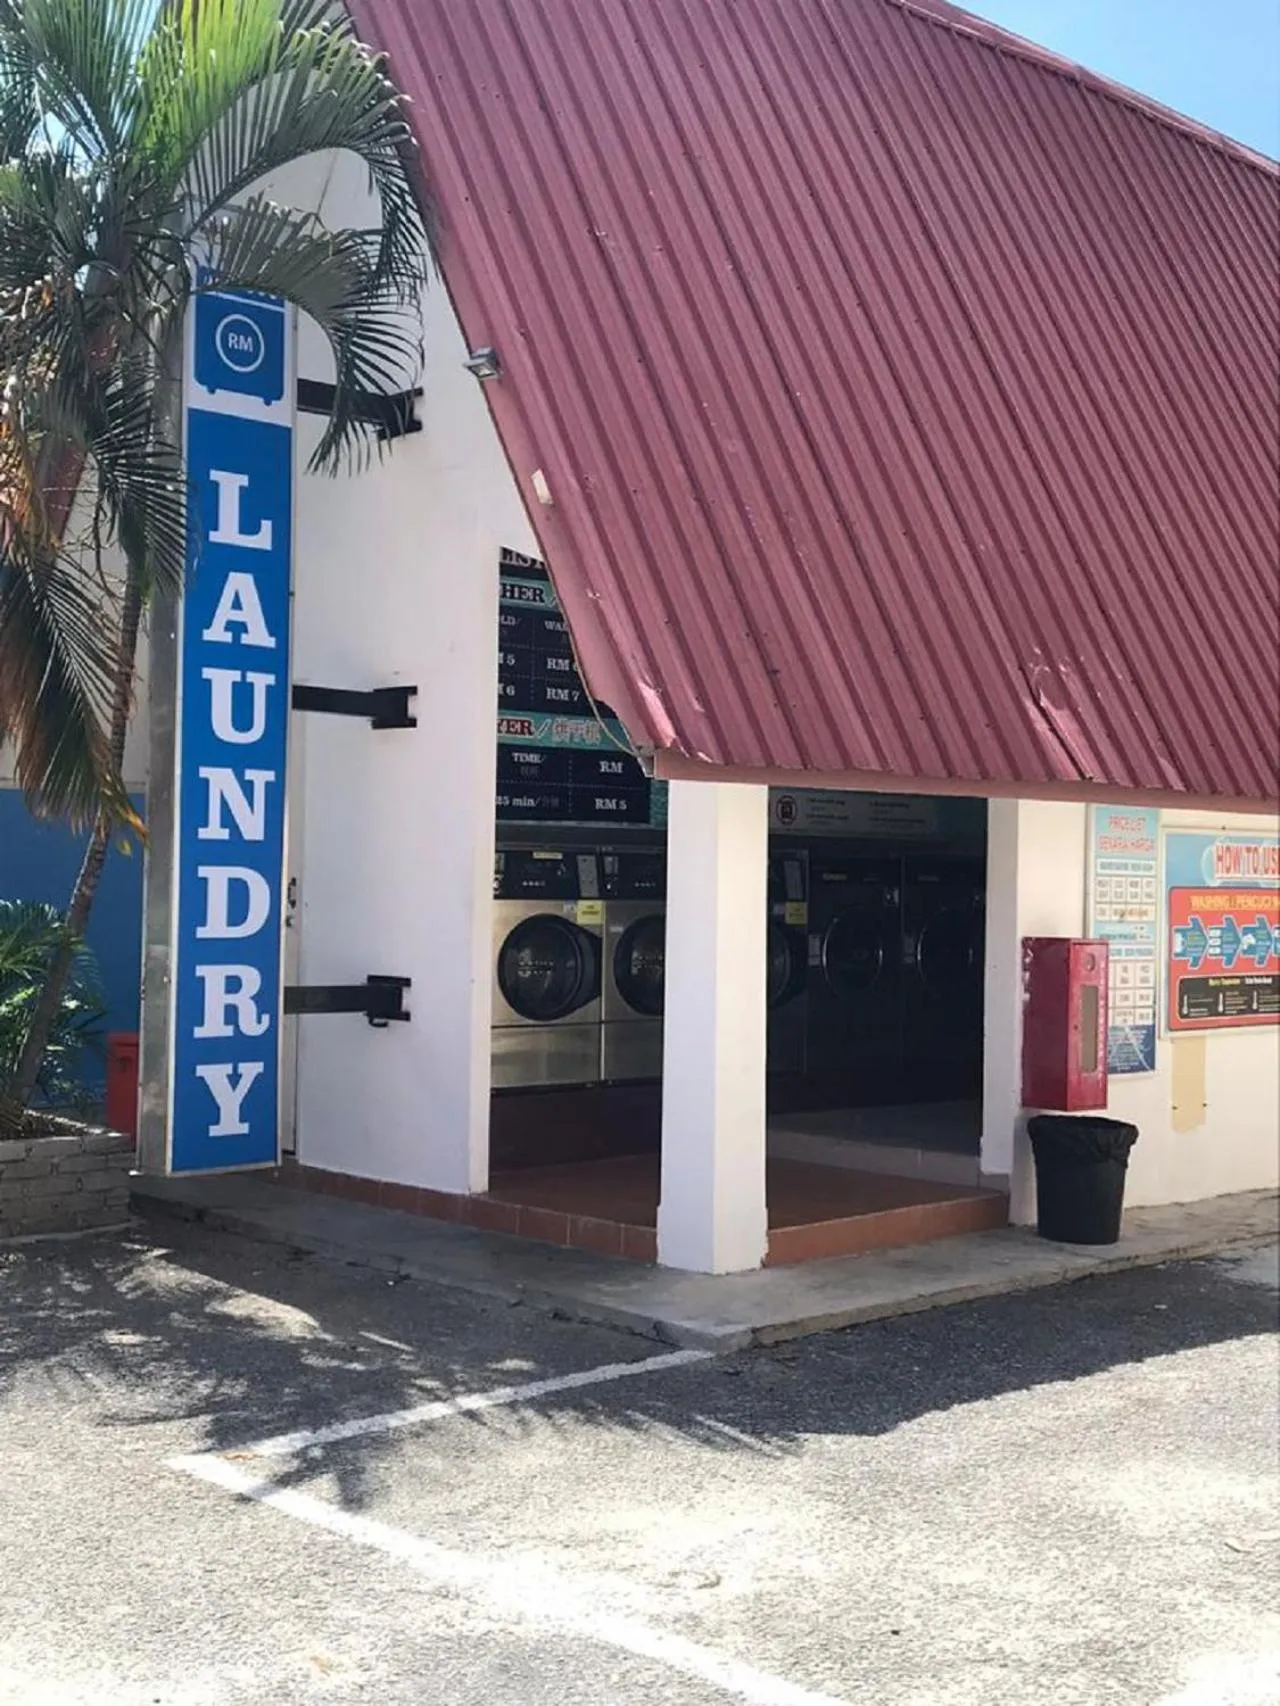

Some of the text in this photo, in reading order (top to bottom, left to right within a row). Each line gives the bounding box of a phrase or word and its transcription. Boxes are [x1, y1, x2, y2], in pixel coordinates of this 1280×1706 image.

[228, 333, 253, 352] RM
[506, 654, 516, 666] 5
[547, 658, 570, 671] RM
[506, 684, 516, 696] 6
[546, 687, 580, 702] RM 7
[599, 760, 623, 773] RM
[193, 469, 276, 1137] LAUNDRY
[595, 798, 627, 810] RM 5
[1214, 843, 1240, 875] HOW
[1244, 844, 1260, 875] TO
